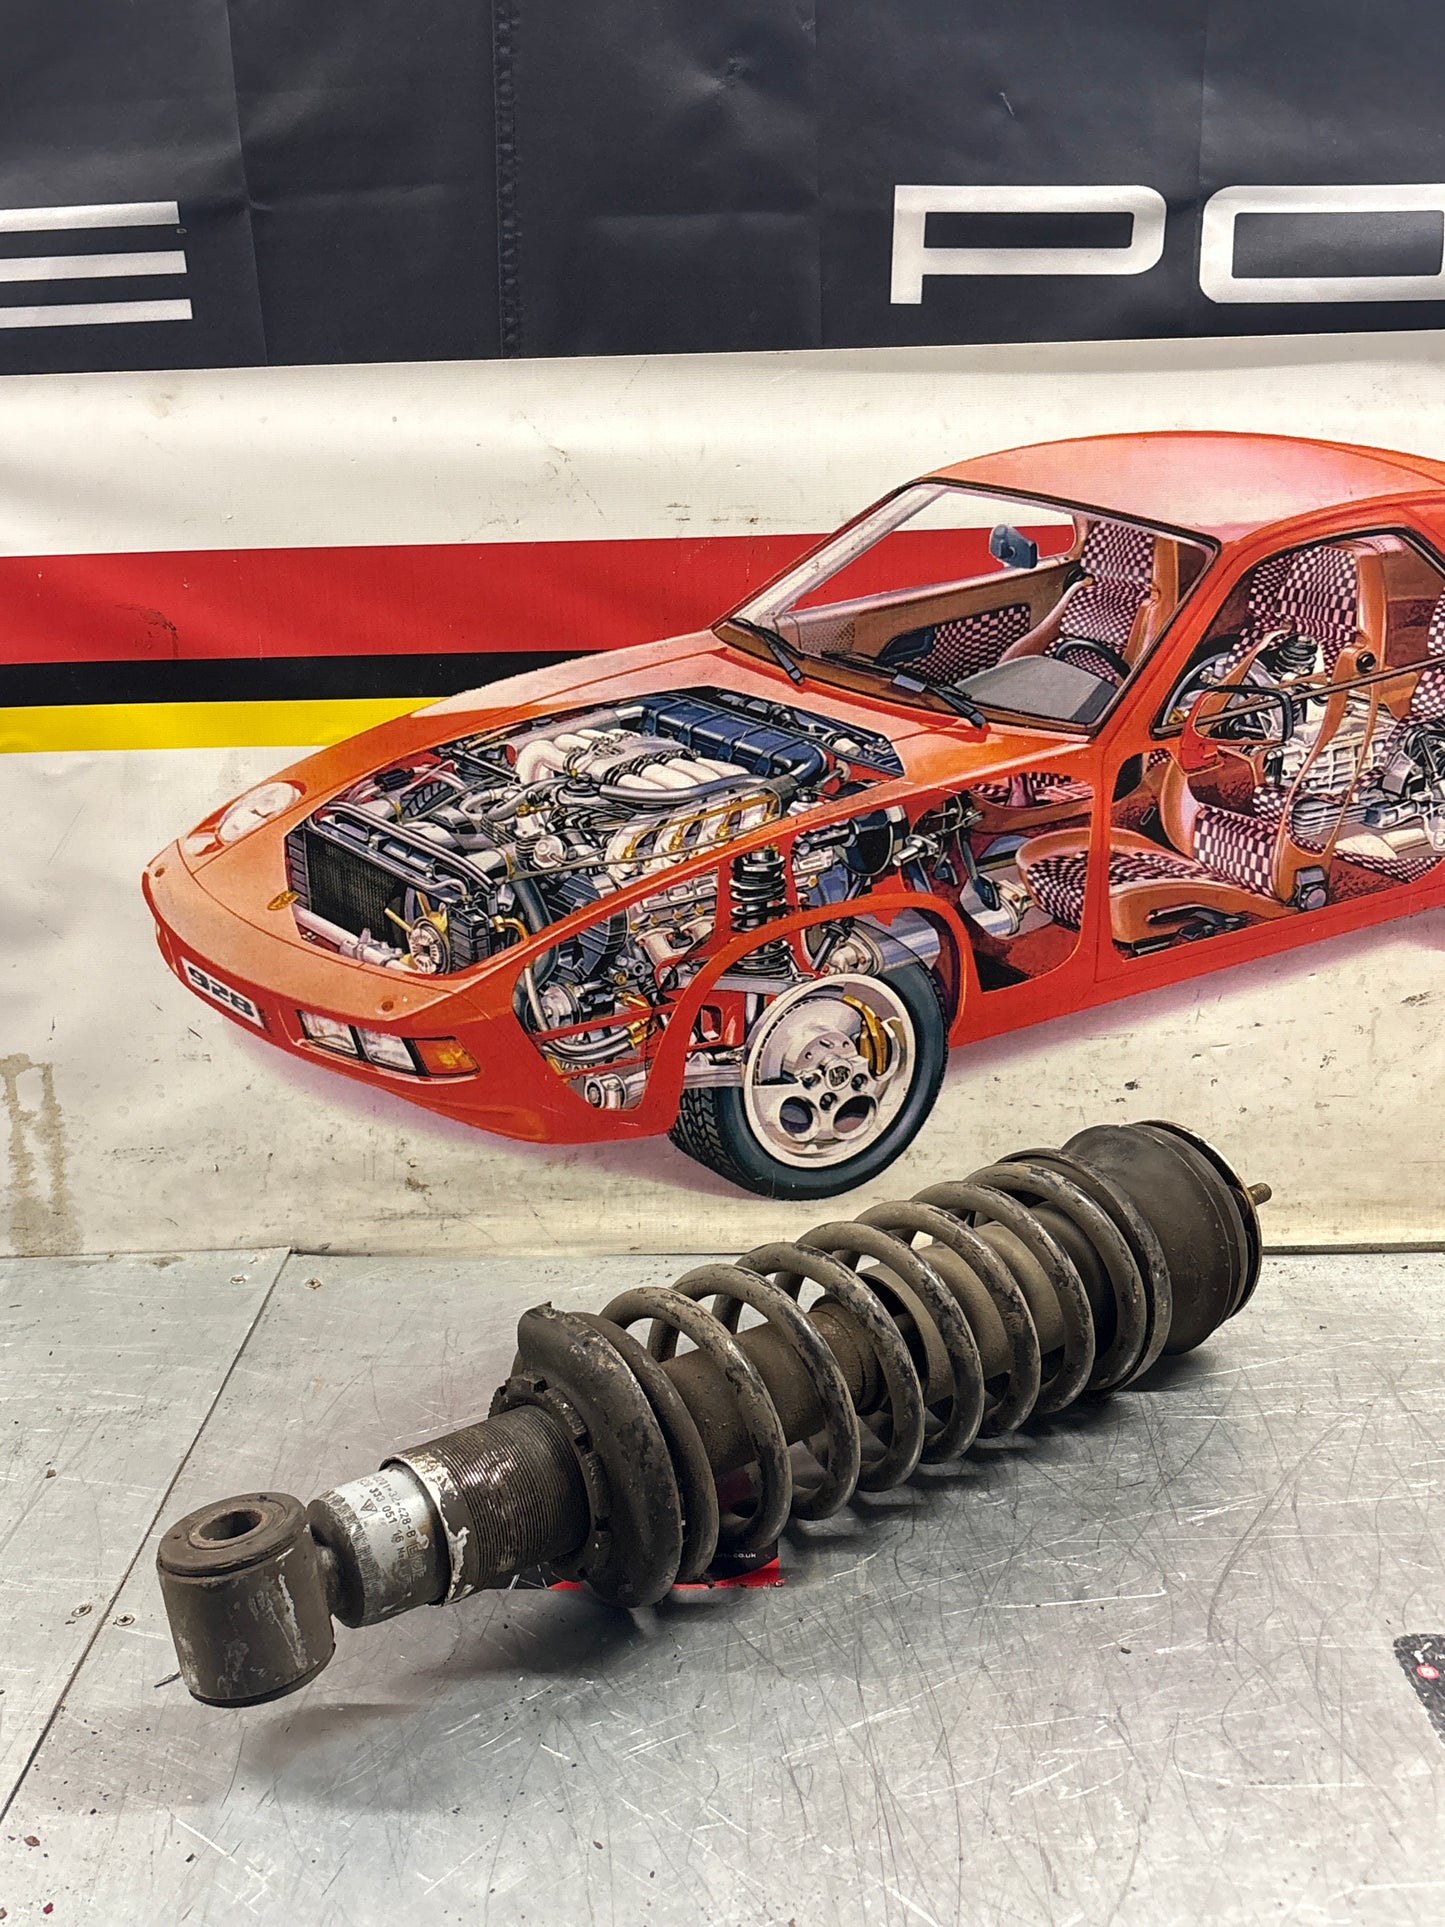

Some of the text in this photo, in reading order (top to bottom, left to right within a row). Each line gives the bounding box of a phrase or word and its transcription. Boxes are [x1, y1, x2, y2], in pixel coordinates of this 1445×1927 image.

[890, 183, 1445, 305] PO
[188, 966, 255, 1018] 928
[382, 1505, 398, 1524] 051
[393, 1529, 404, 1543] 16
